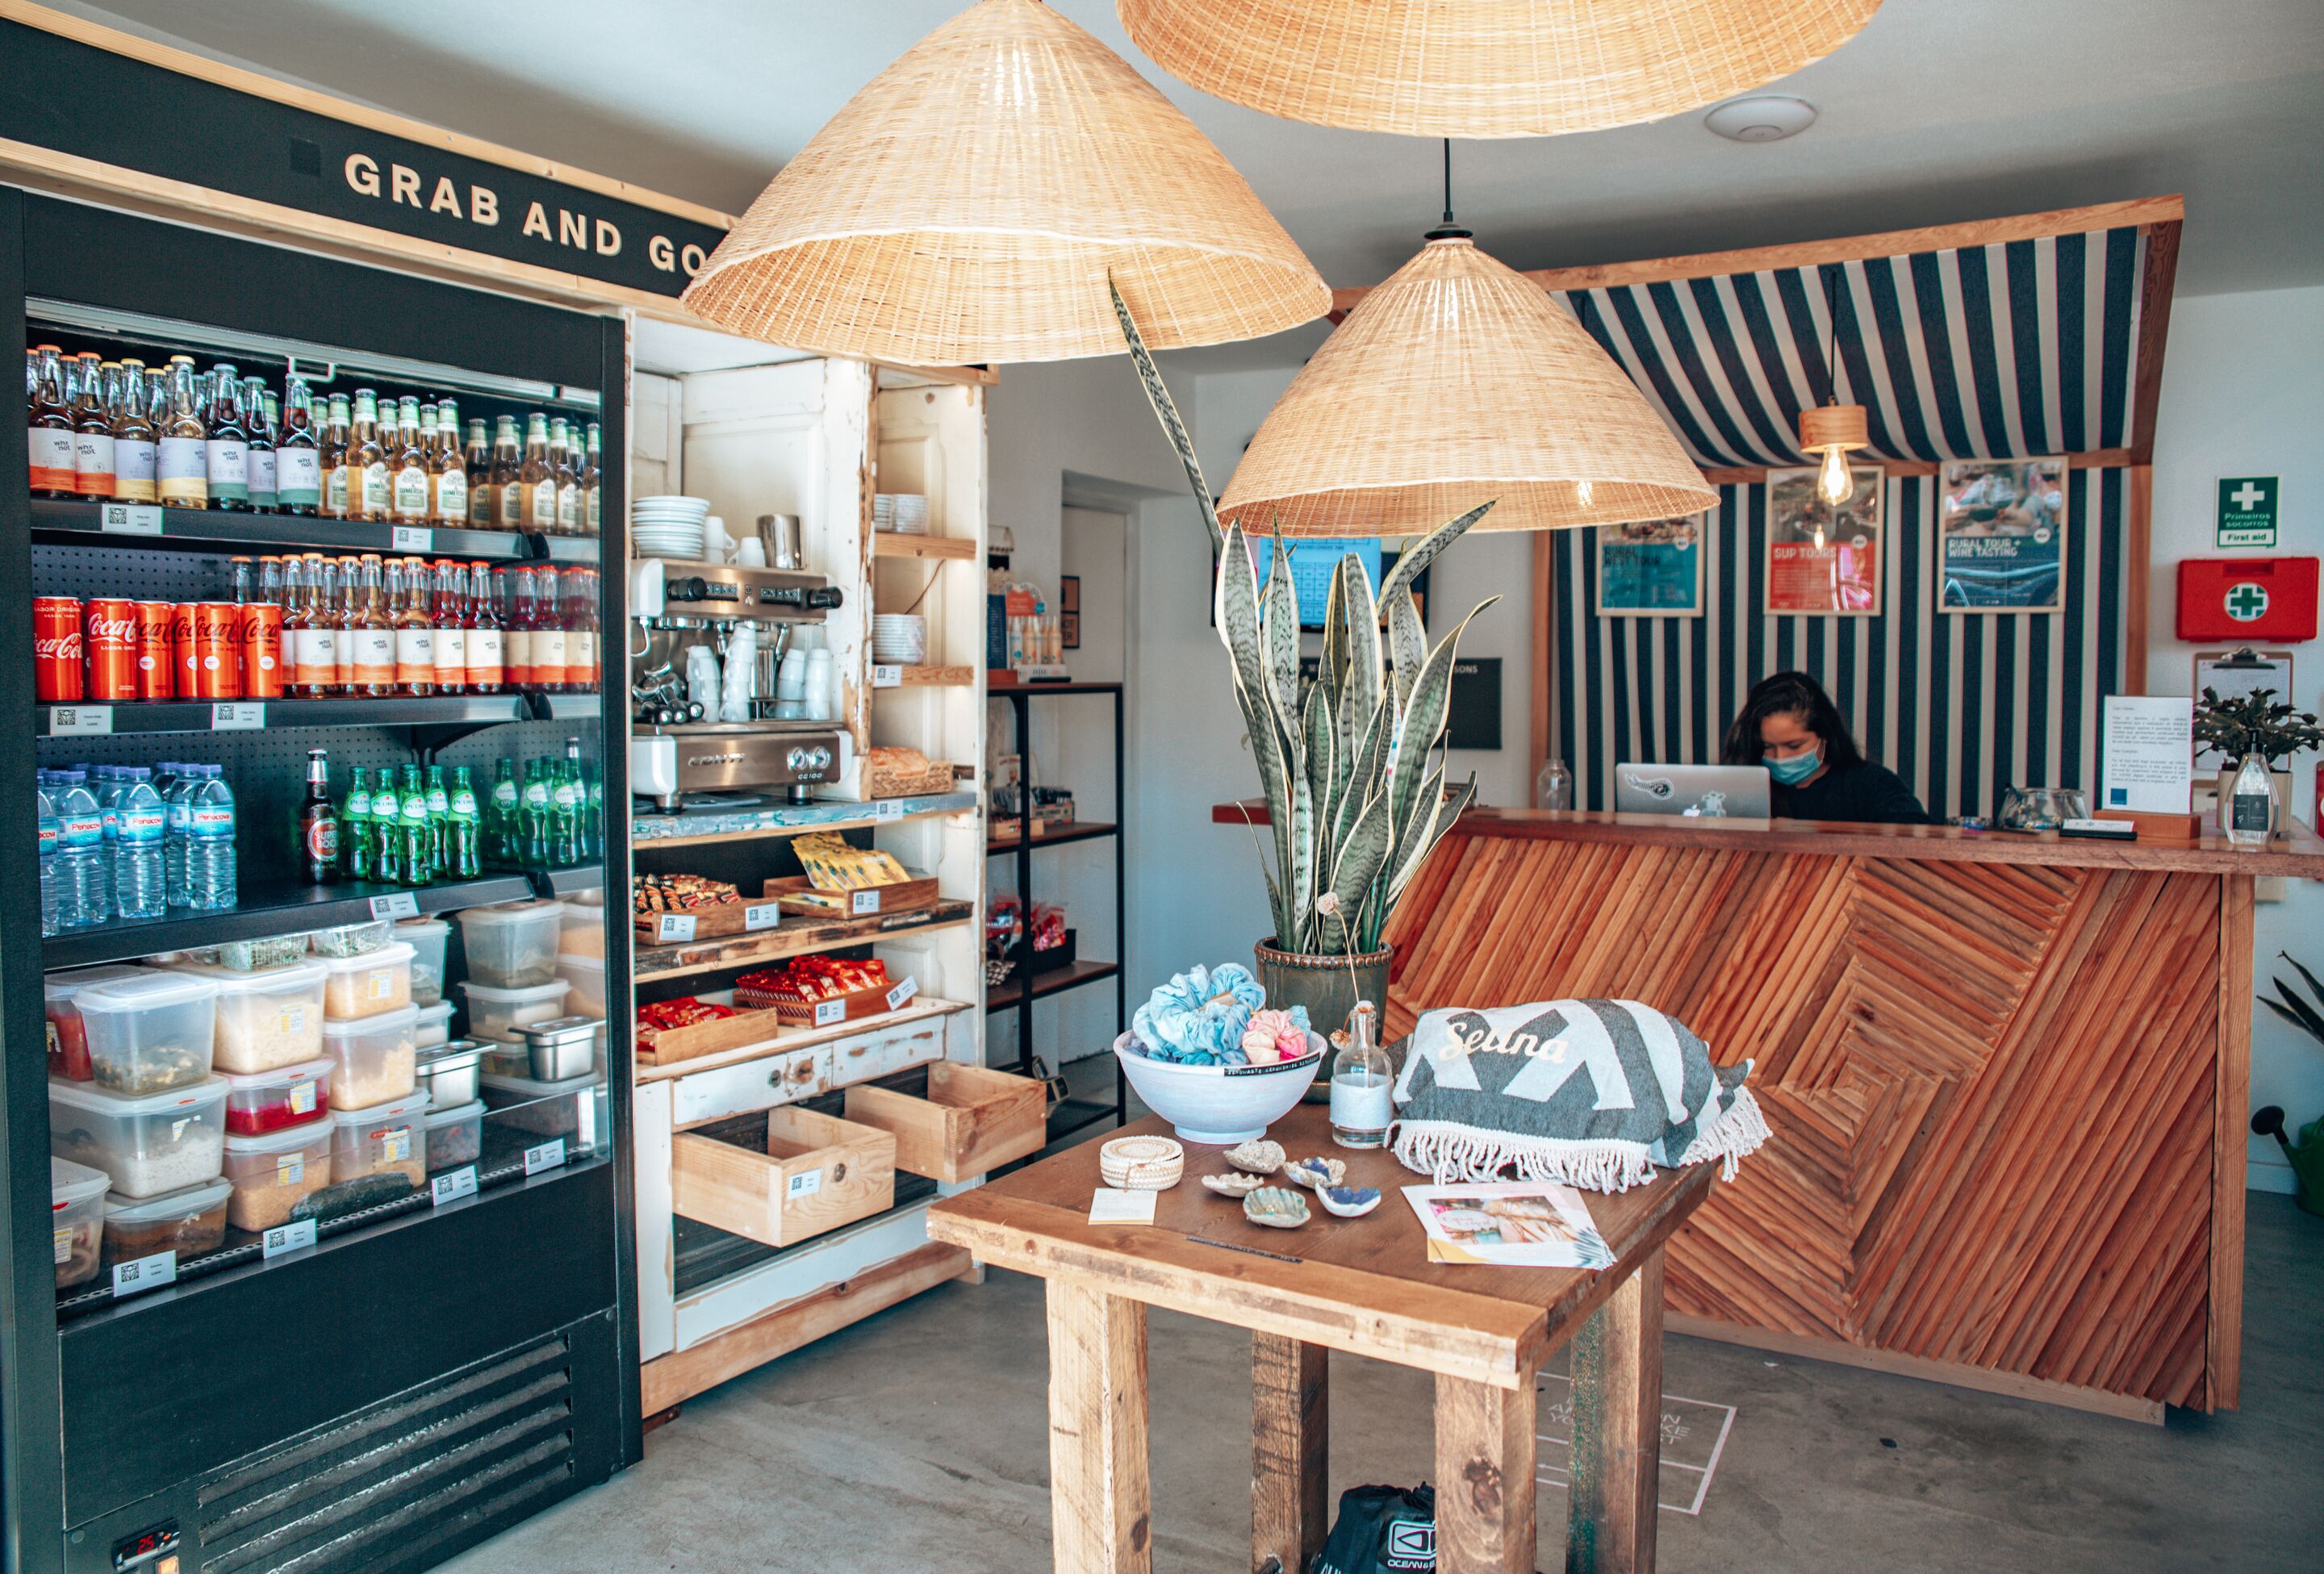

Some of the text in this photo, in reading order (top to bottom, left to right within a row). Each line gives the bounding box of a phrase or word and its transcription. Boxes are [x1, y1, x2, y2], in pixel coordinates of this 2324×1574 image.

[345, 153, 708, 278] GRAB AND GO
[2225, 512, 2272, 520] Primeiros
[1949, 539, 1982, 549] RURAL
[1984, 539, 2011, 549] TOUR
[1774, 548, 1837, 558] SUP TOURS
[1949, 548, 2017, 557] WINE TASTING
